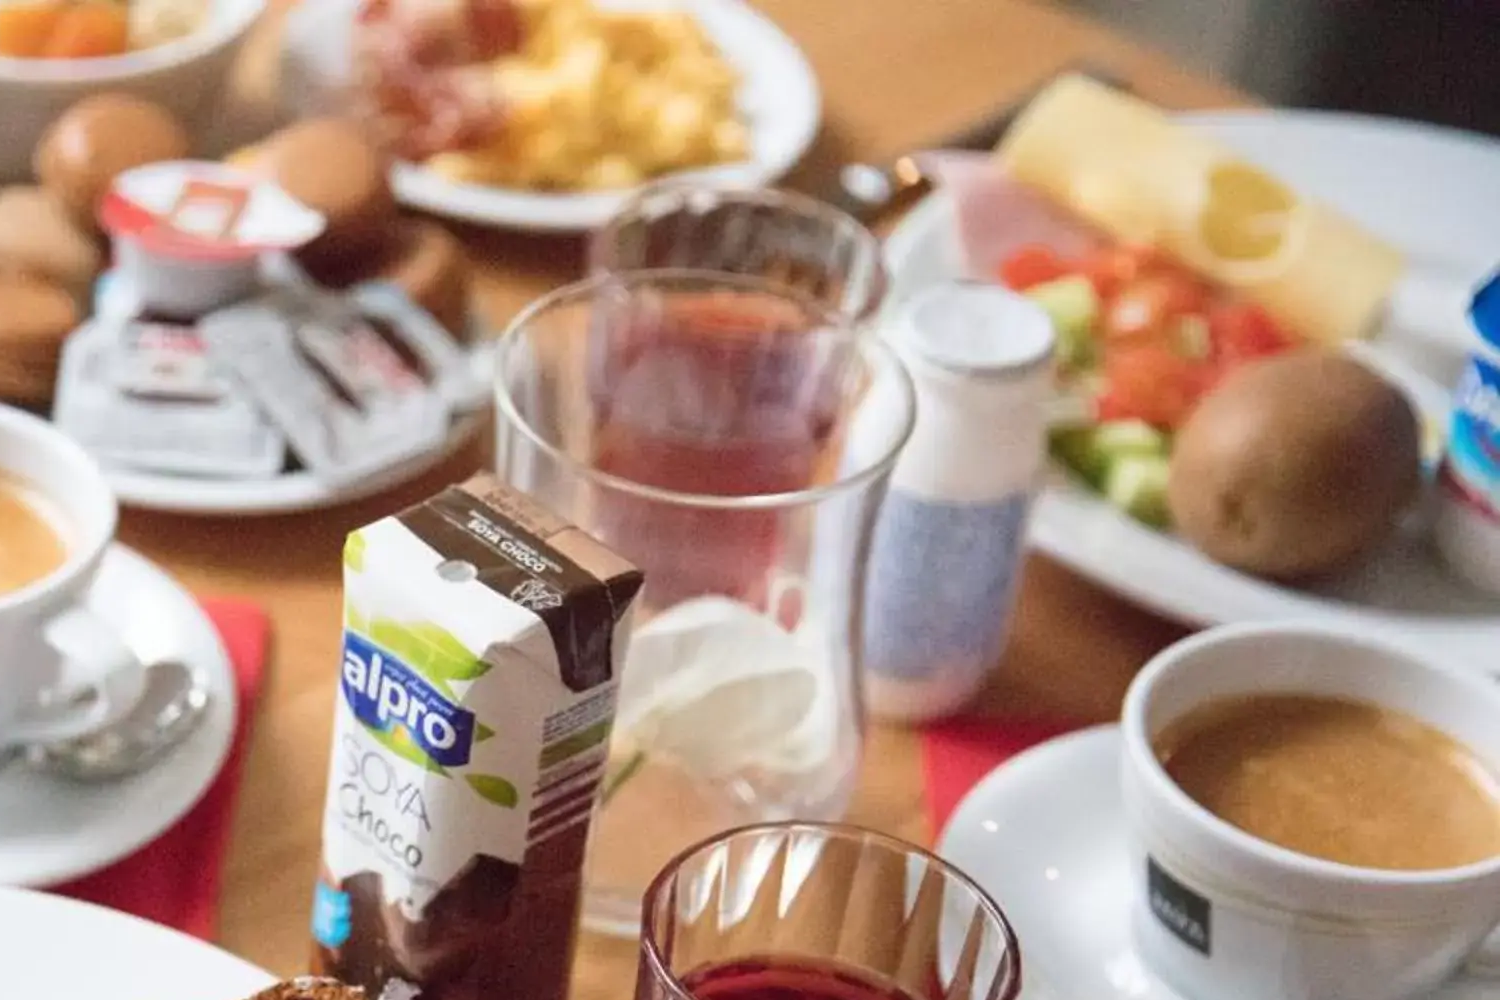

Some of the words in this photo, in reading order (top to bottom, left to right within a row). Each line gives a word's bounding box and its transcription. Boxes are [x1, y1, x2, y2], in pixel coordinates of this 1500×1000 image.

[467, 518, 501, 544] SOYA
[500, 540, 546, 573] CHOCO
[342, 651, 457, 750] alpro
[339, 782, 423, 868] Choco
[342, 733, 432, 833] SOYA
